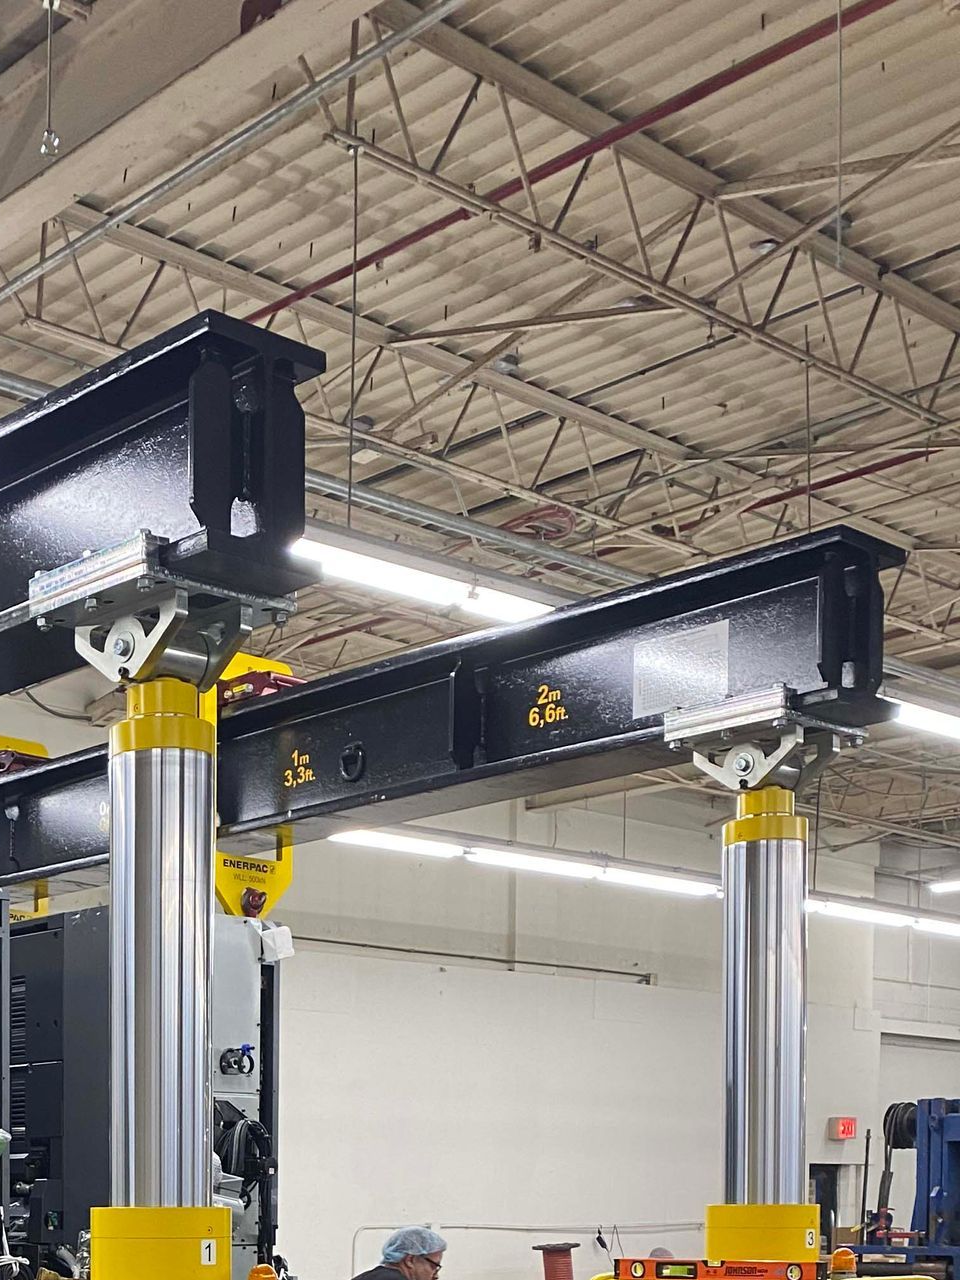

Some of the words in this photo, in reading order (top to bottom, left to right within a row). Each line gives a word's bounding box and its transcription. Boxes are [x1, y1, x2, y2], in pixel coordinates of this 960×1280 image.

[537, 684, 561, 705] 2m
[528, 703, 569, 728] 6,6ft.
[291, 749, 310, 767] 1m
[284, 766, 316, 788] 3,3ft.
[223, 858, 268, 873] ENERPAC
[807, 1231, 814, 1246] 3
[204, 1242, 212, 1262] 1
[724, 1266, 757, 1276] JOHNSON
